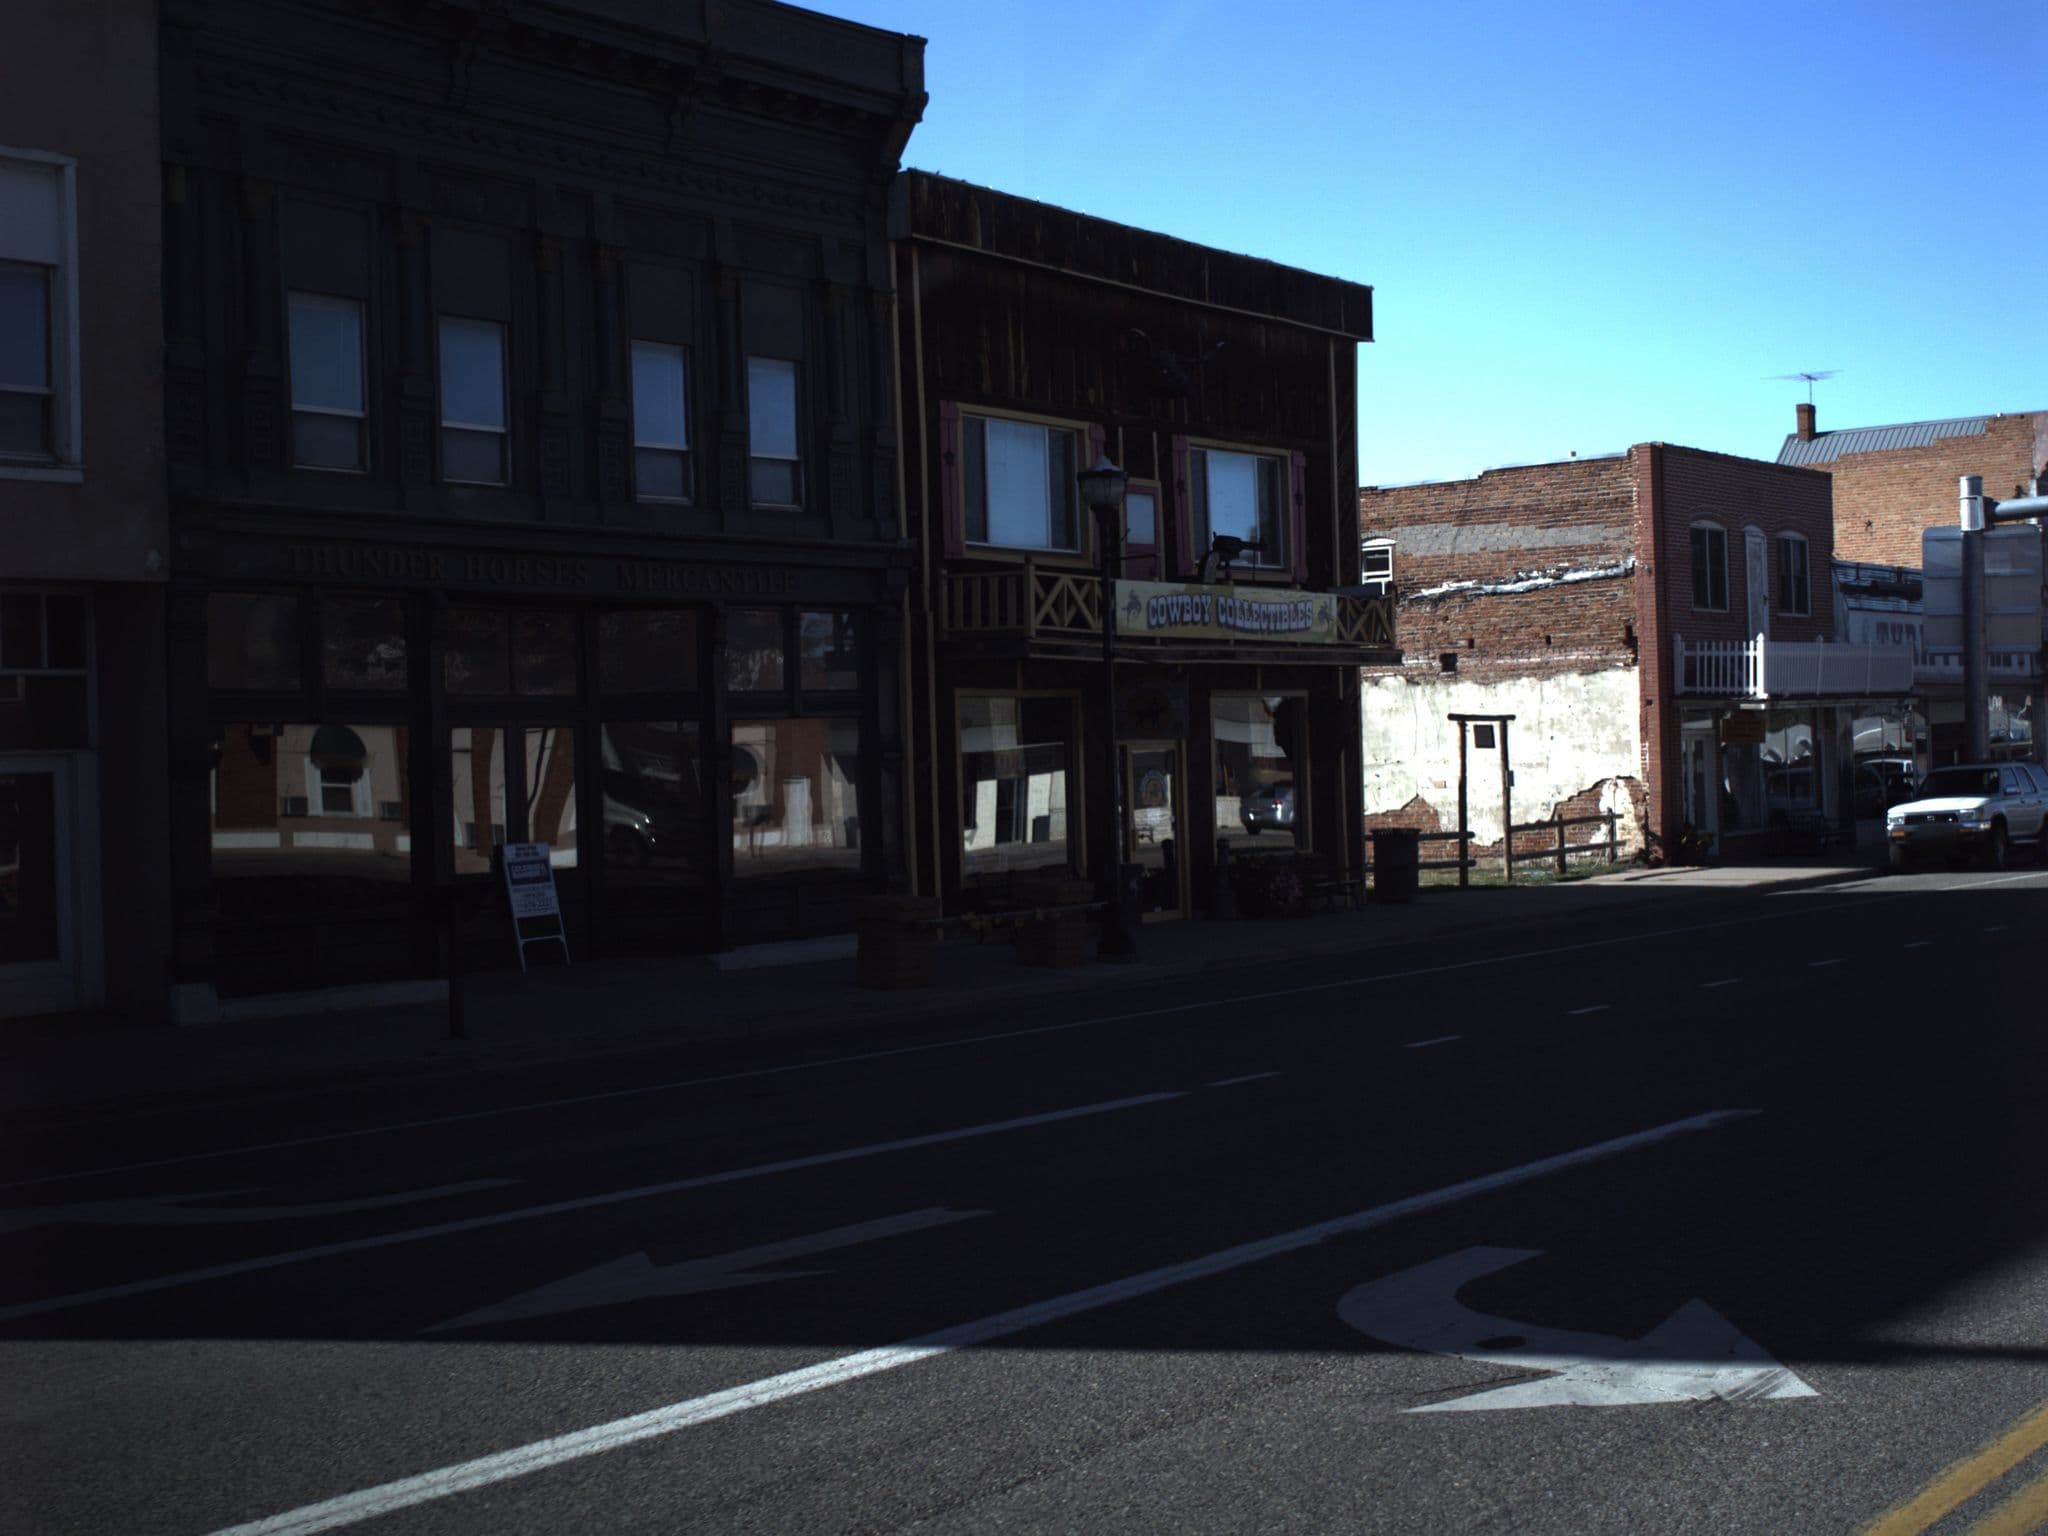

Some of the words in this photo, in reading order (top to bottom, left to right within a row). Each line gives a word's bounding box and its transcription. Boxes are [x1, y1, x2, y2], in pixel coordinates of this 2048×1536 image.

[287, 543, 449, 585] THUNDER
[464, 552, 590, 586] HORSES
[616, 562, 795, 593] MERCANTILE
[1147, 594, 1211, 628] COWBOY
[1216, 596, 1313, 634] COLLECTIBLES
